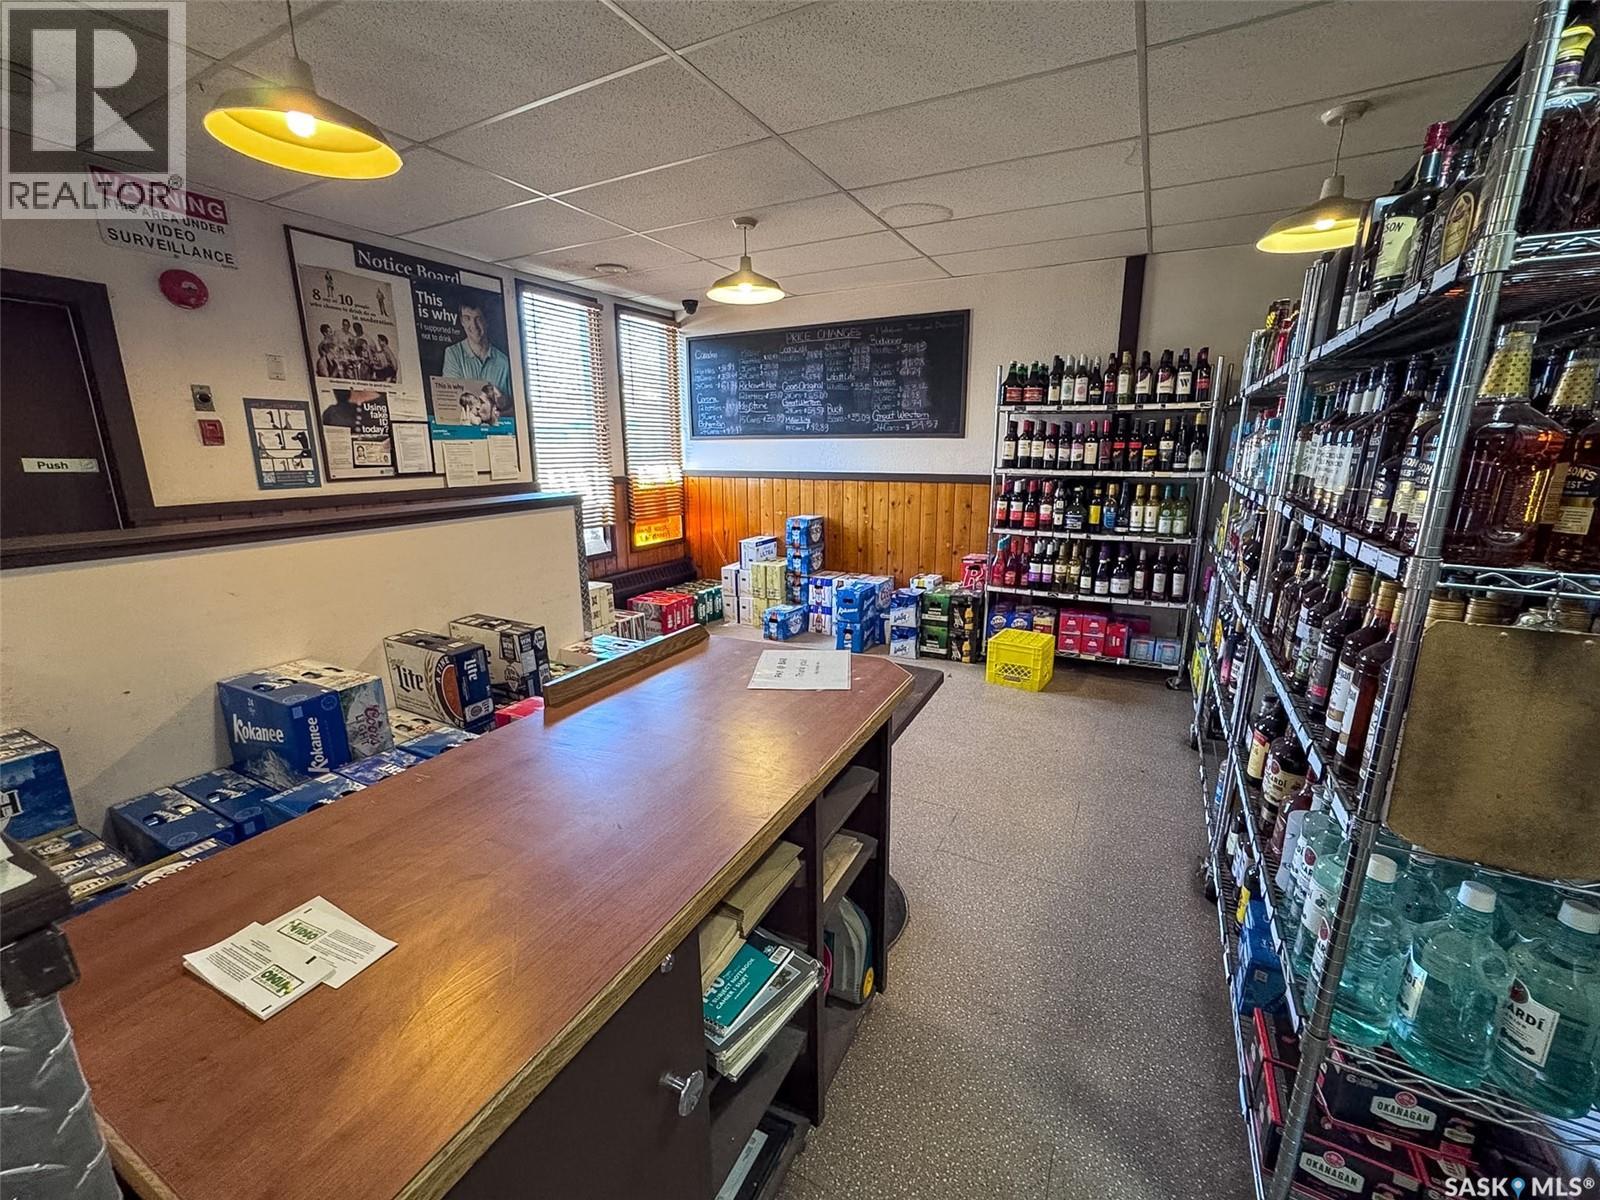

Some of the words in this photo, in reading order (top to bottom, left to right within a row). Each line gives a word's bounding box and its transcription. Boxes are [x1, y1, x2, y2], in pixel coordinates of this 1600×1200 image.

[142, 206, 180, 225] AREA
[182, 217, 226, 235] UNDER
[145, 221, 196, 242] VIDEO
[107, 227, 235, 265] SURVEILLANCE
[357, 249, 413, 275] Notice
[416, 263, 460, 284] Board
[311, 287, 321, 301] 8
[338, 294, 353, 307] 10
[415, 289, 443, 307] This
[418, 304, 429, 318] is
[431, 306, 458, 326] why
[421, 332, 431, 342] not
[431, 333, 438, 342] to
[424, 324, 451, 336] supported
[785, 331, 811, 344] PRICE
[817, 327, 861, 339] CHANGES
[363, 402, 388, 414] Using
[370, 410, 388, 420] fake
[362, 425, 389, 436] today?
[379, 418, 388, 426] ID
[37, 460, 69, 470] Push
[394, 663, 424, 693] Lite
[463, 659, 479, 681] Lite
[232, 713, 285, 744] Kokanee
[354, 713, 371, 746] LIGHT
[307, 716, 331, 773] Kokanee
[713, 982, 732, 1004] SUBJECT
[730, 957, 755, 984] NOTEBOOK
[715, 991, 734, 1010] CAHIER
[1506, 1002, 1547, 1032] ARDÍ
[1376, 1101, 1431, 1125] OKANAGAN
[1305, 1157, 1359, 1187] OKANAGAN
